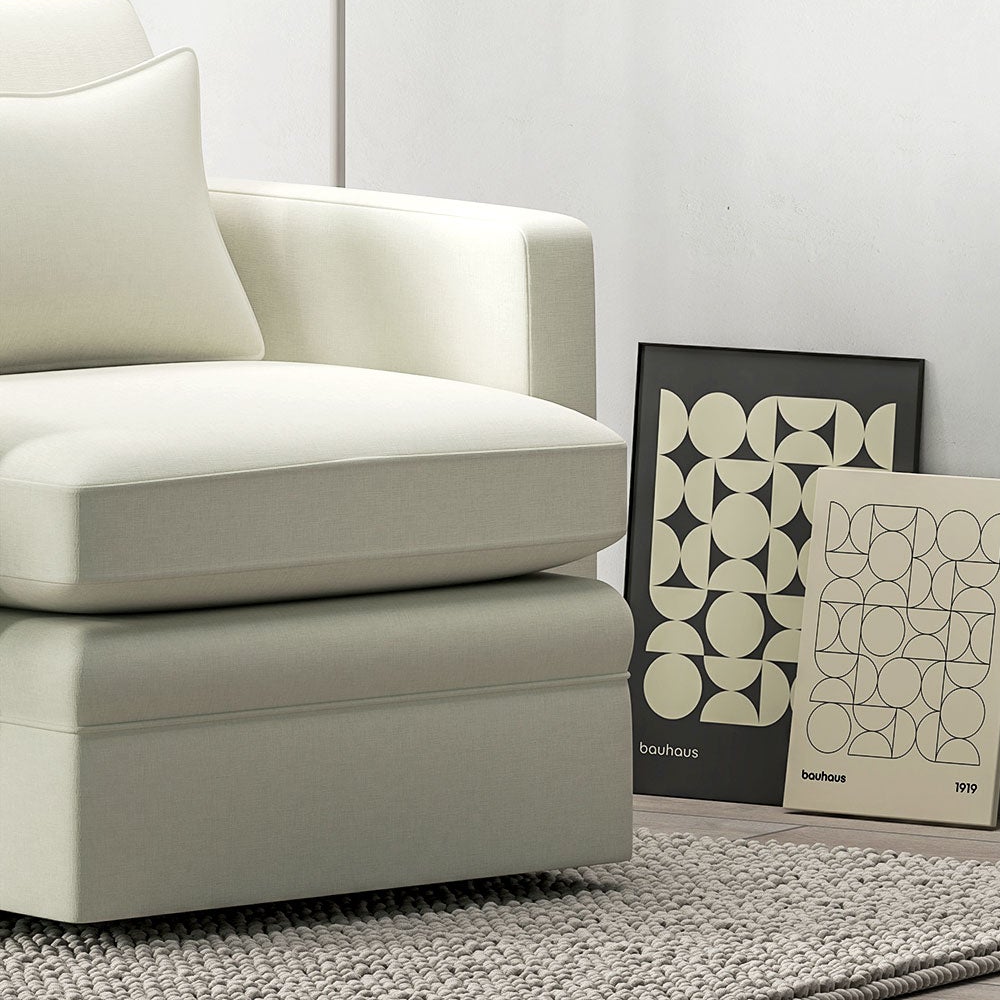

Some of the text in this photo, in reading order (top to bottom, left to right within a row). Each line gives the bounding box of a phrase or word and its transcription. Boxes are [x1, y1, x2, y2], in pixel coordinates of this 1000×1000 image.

[639, 741, 699, 759] bauhaus
[801, 769, 847, 783] bauhaus
[955, 782, 978, 793] 1919
